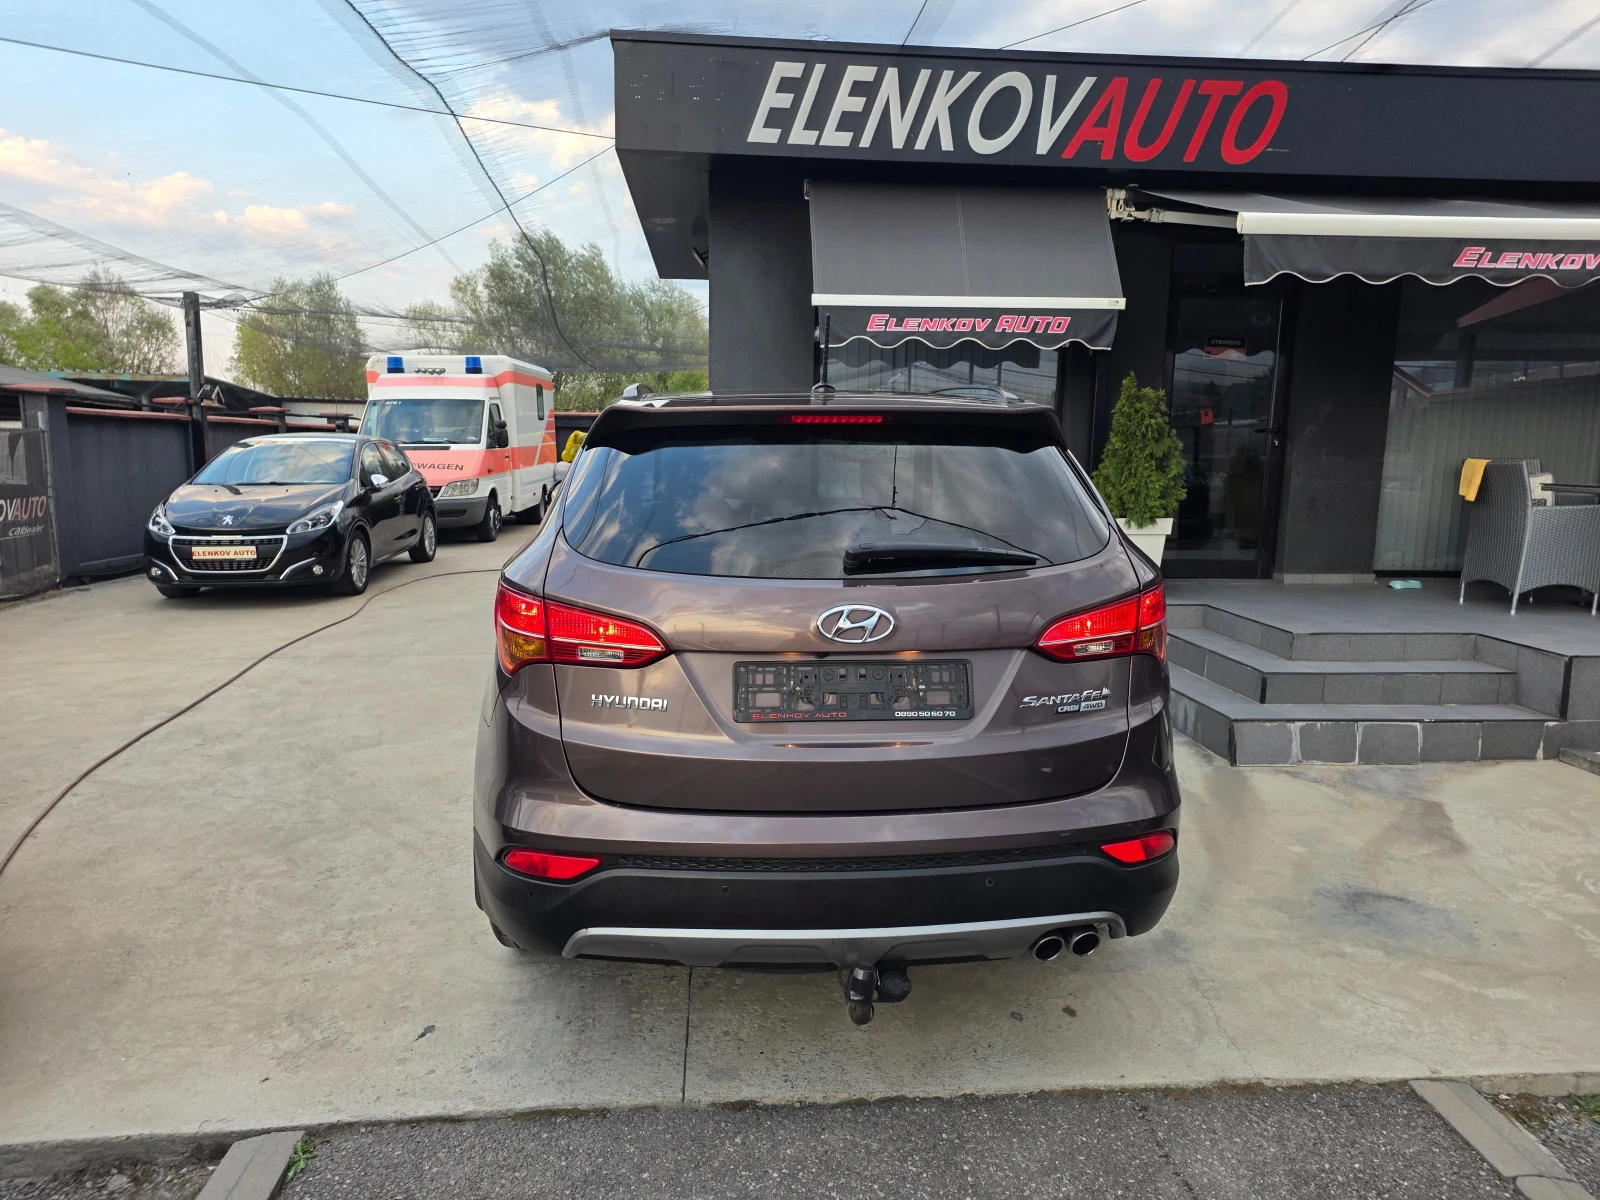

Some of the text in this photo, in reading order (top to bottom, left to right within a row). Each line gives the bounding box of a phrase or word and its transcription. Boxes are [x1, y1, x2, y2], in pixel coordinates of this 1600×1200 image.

[1452, 246, 1600, 270] ELENKOV
[866, 313, 1072, 334] ELENKOV AUTO
[591, 693, 669, 712] HYUNDAI
[1082, 701, 1104, 711] 4WD
[814, 711, 848, 719] AUTO
